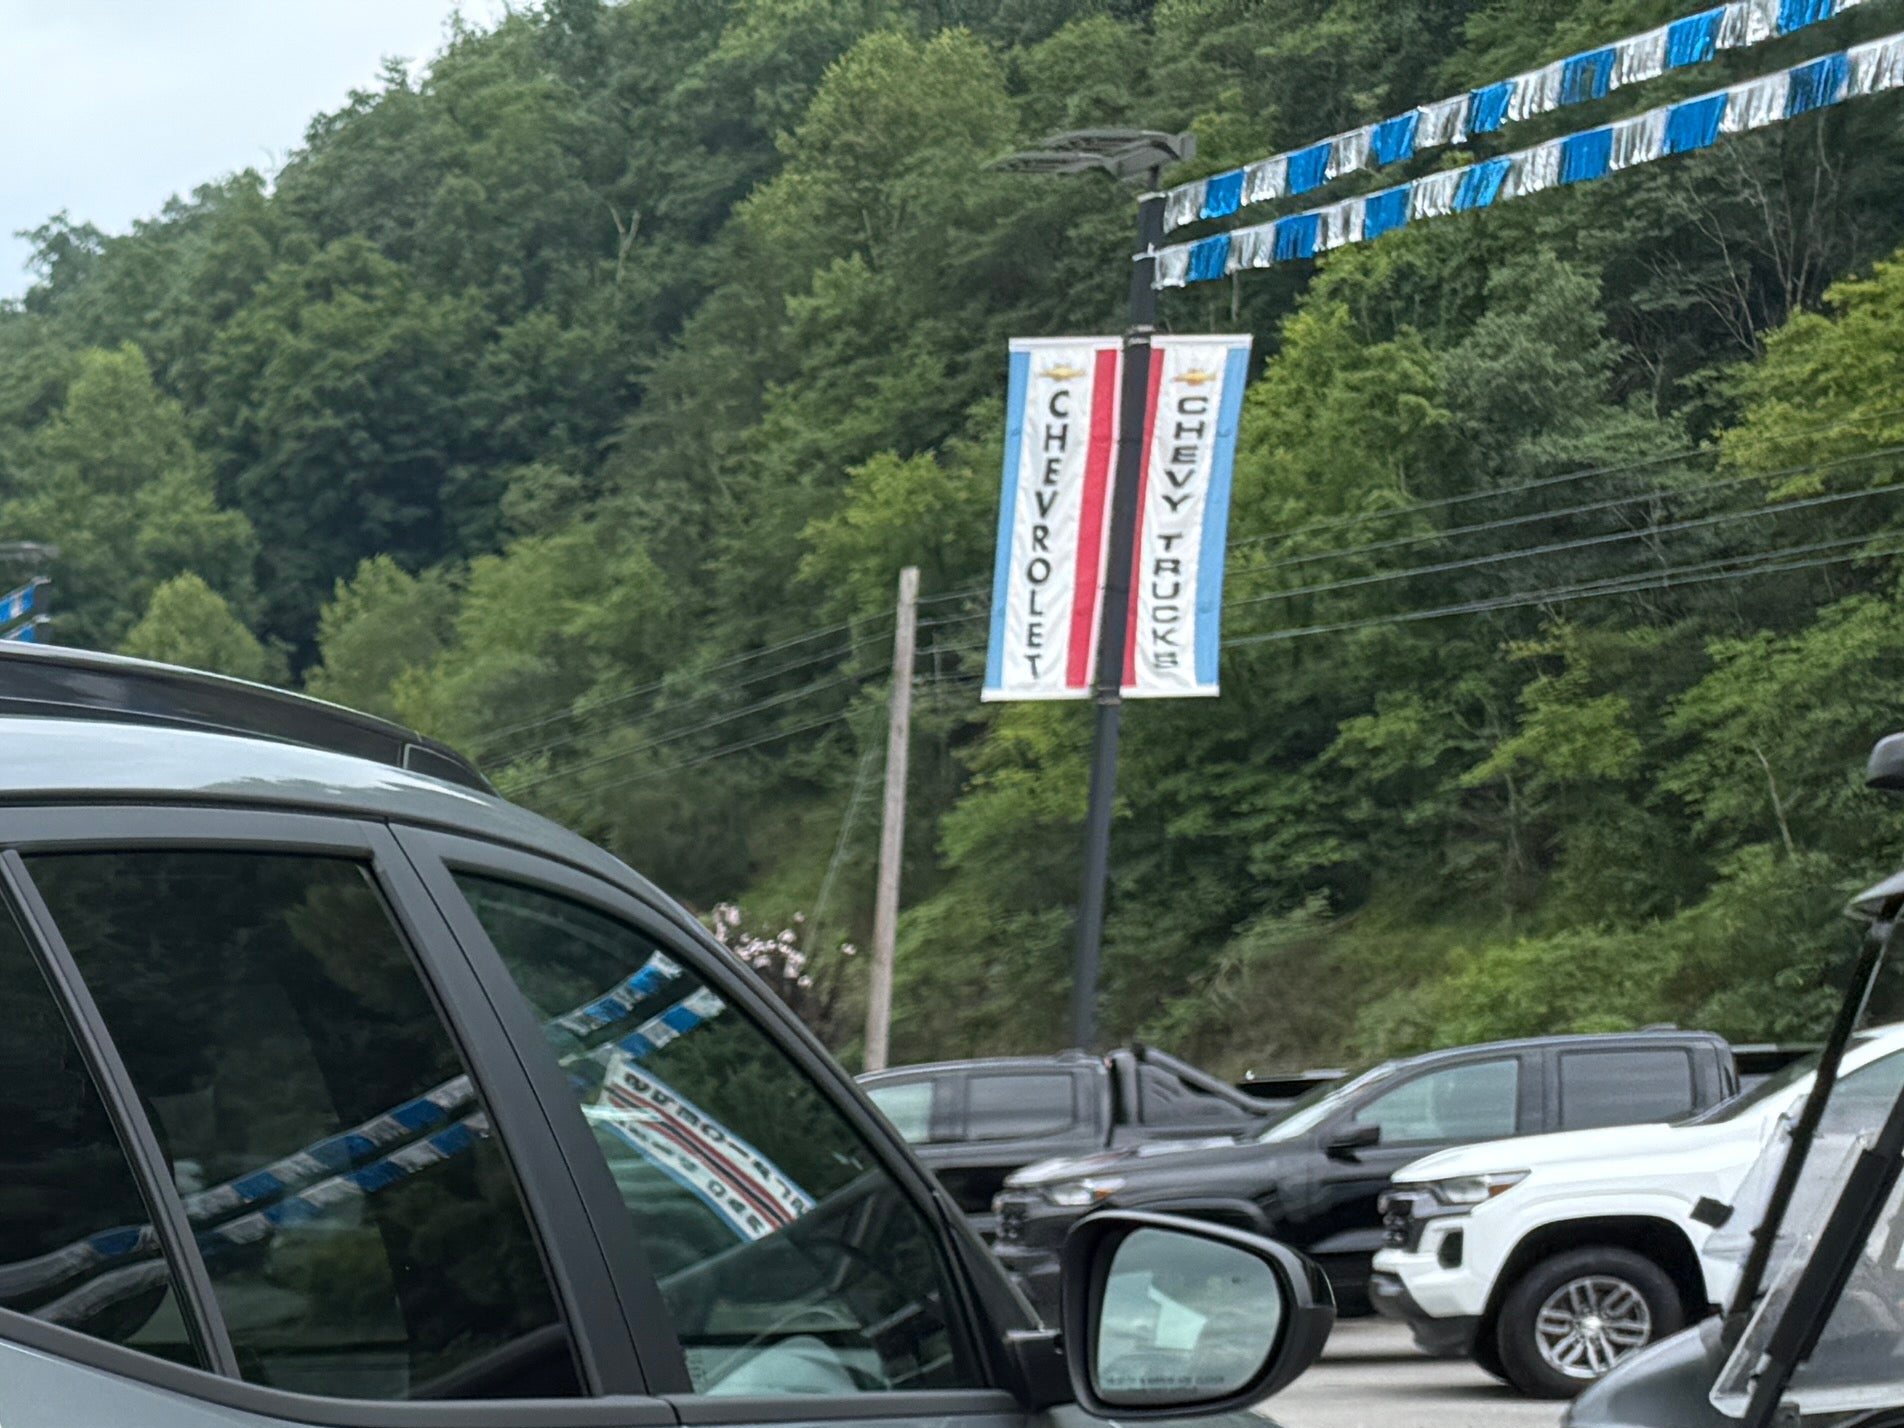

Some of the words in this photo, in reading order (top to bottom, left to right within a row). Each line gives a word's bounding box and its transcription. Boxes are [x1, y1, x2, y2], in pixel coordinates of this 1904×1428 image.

[1161, 397, 1208, 513] CHEVY
[1024, 390, 1069, 680] CHEVROLET
[1152, 534, 1183, 669] TRUCKS
